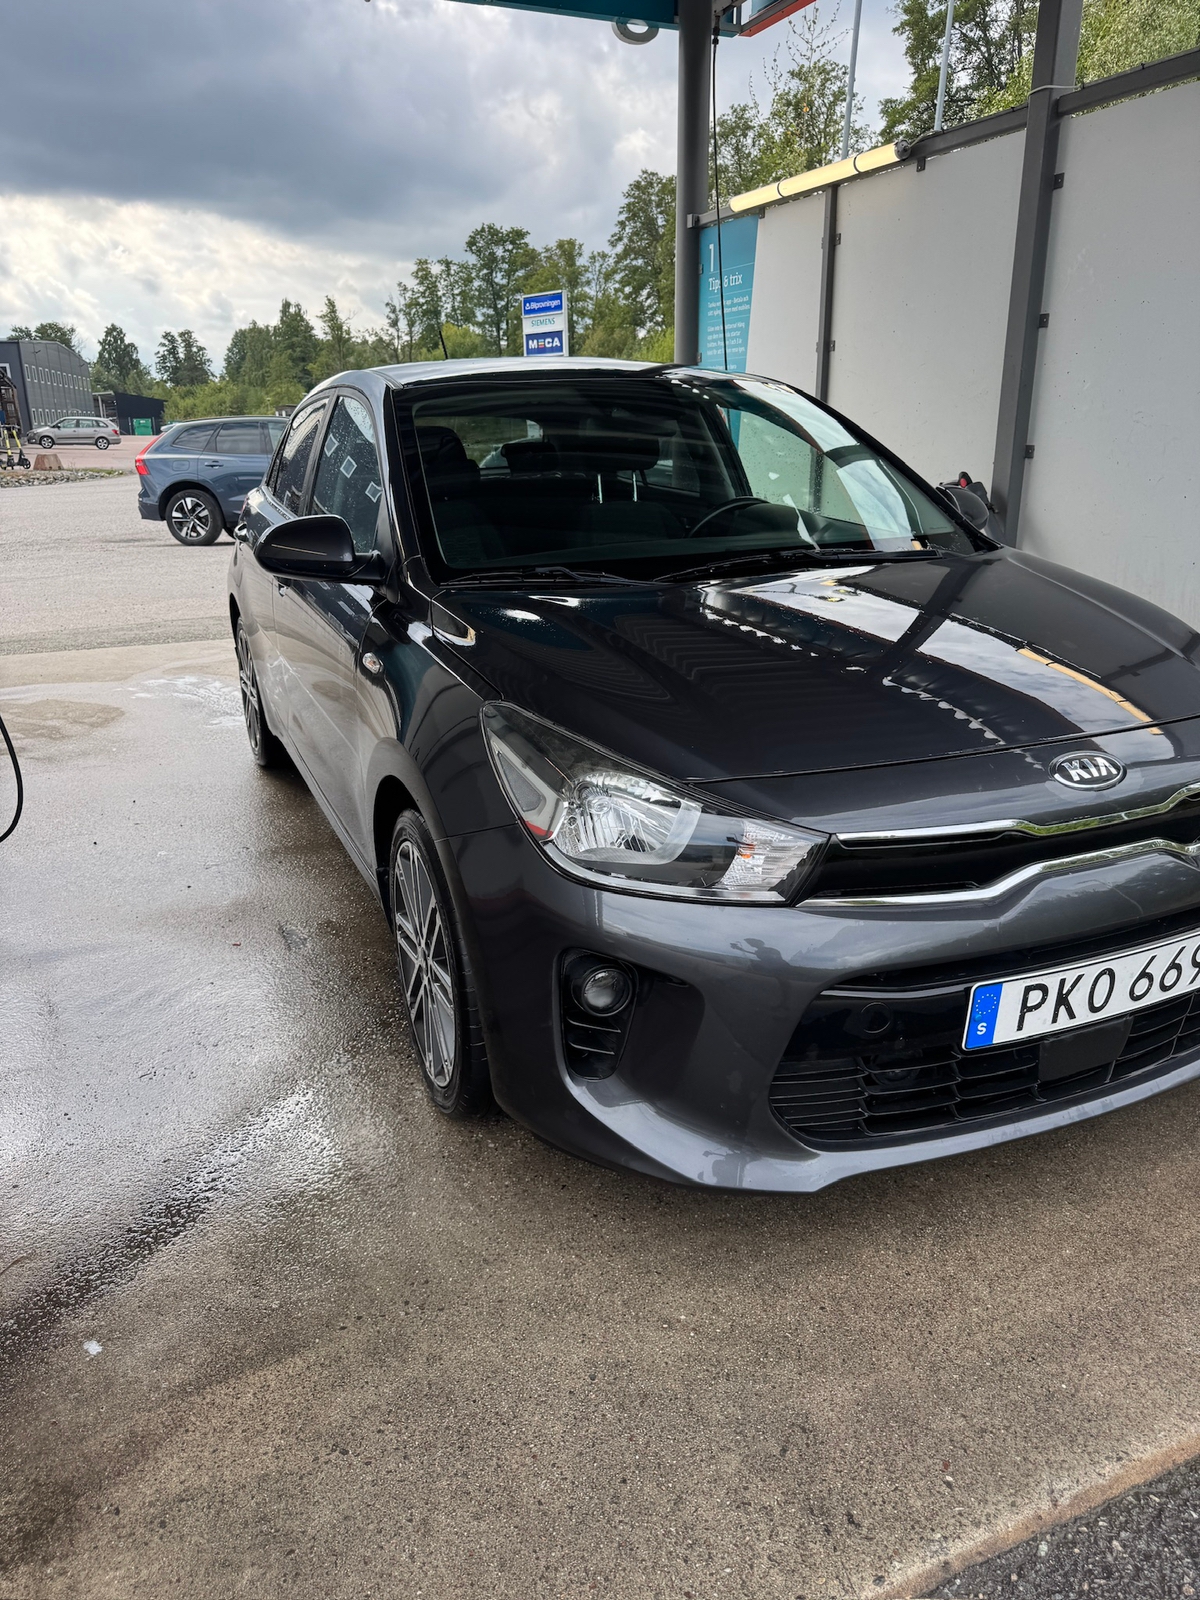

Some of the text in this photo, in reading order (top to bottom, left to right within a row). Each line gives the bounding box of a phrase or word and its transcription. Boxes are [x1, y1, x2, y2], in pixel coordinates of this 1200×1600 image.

[709, 243, 714, 272] 1
[723, 275, 729, 287] &
[730, 272, 742, 286] trix
[530, 299, 560, 310] Bilprovningen
[531, 317, 555, 327] SIEMENS
[529, 337, 560, 349] MECA
[1061, 757, 1118, 782] KIA
[1016, 967, 1116, 1032] PKO
[976, 1022, 987, 1035] S
